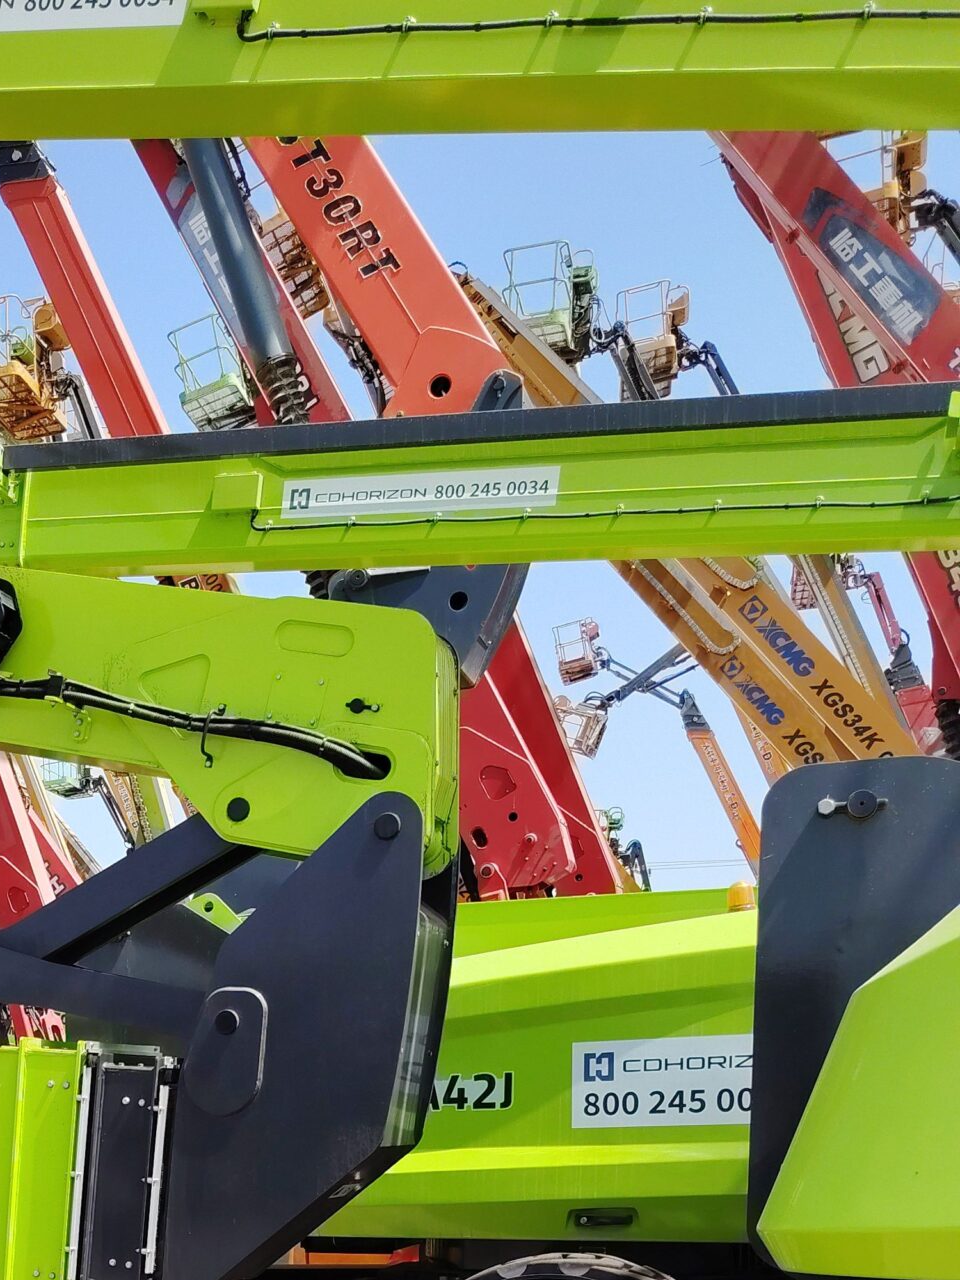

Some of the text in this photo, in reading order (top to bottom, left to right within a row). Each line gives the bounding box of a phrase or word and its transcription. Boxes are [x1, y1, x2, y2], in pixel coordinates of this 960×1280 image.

[434, 484, 466, 499] 800
[470, 482, 502, 498] 245
[506, 479, 550, 496] 0034
[734, 674, 785, 726] XCMG
[754, 616, 885, 750] XCMG XGS34K
[583, 1091, 639, 1116] 800
[648, 1089, 706, 1114] 245
